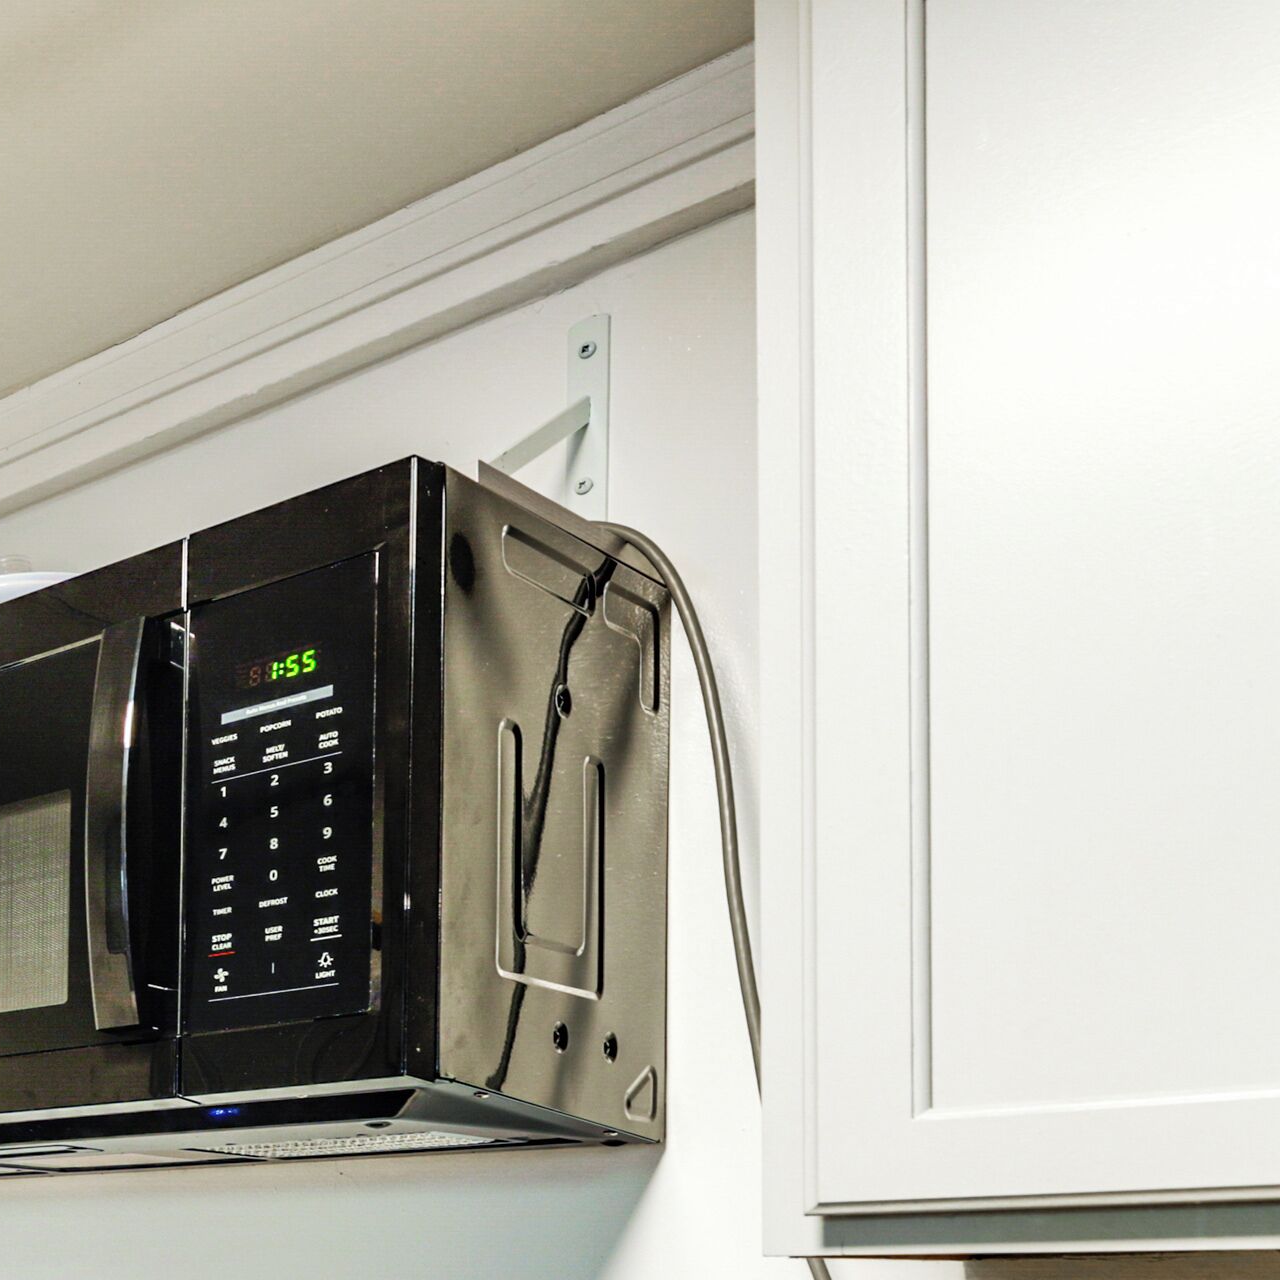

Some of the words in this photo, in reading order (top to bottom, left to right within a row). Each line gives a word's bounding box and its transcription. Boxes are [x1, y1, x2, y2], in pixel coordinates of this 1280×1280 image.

[271, 649, 317, 680] 1:55
[315, 706, 343, 719] POTATO
[260, 719, 292, 733] POPCORN
[211, 733, 238, 745] VEGGIES
[319, 731, 339, 741] AUTO
[265, 744, 285, 754] MELT/
[318, 739, 339, 749] COOK
[214, 756, 235, 767] SNACK
[262, 751, 288, 763] SOFTEN
[213, 764, 236, 774] MENUS
[323, 762, 333, 774] 3
[270, 774, 279, 786] 2
[220, 786, 227, 797] 1
[323, 794, 332, 806] 6
[270, 806, 279, 818] 5
[219, 817, 228, 828] 4
[323, 827, 332, 839] 9
[269, 838, 279, 849] 8
[219, 848, 228, 860] 7
[317, 855, 338, 865] COOK
[319, 863, 335, 872] TIME
[211, 875, 234, 884] POWER
[269, 869, 278, 881] 0
[213, 883, 232, 892] LEVEL
[315, 888, 338, 898] CLOCK
[259, 896, 288, 908] DEFROST
[213, 907, 232, 916] TIMER
[313, 915, 339, 927] START
[265, 925, 283, 934] USER
[212, 933, 232, 943] STOP
[265, 933, 282, 942] PREF
[212, 942, 232, 951] CLEAR
[315, 970, 336, 979] LIGHT
